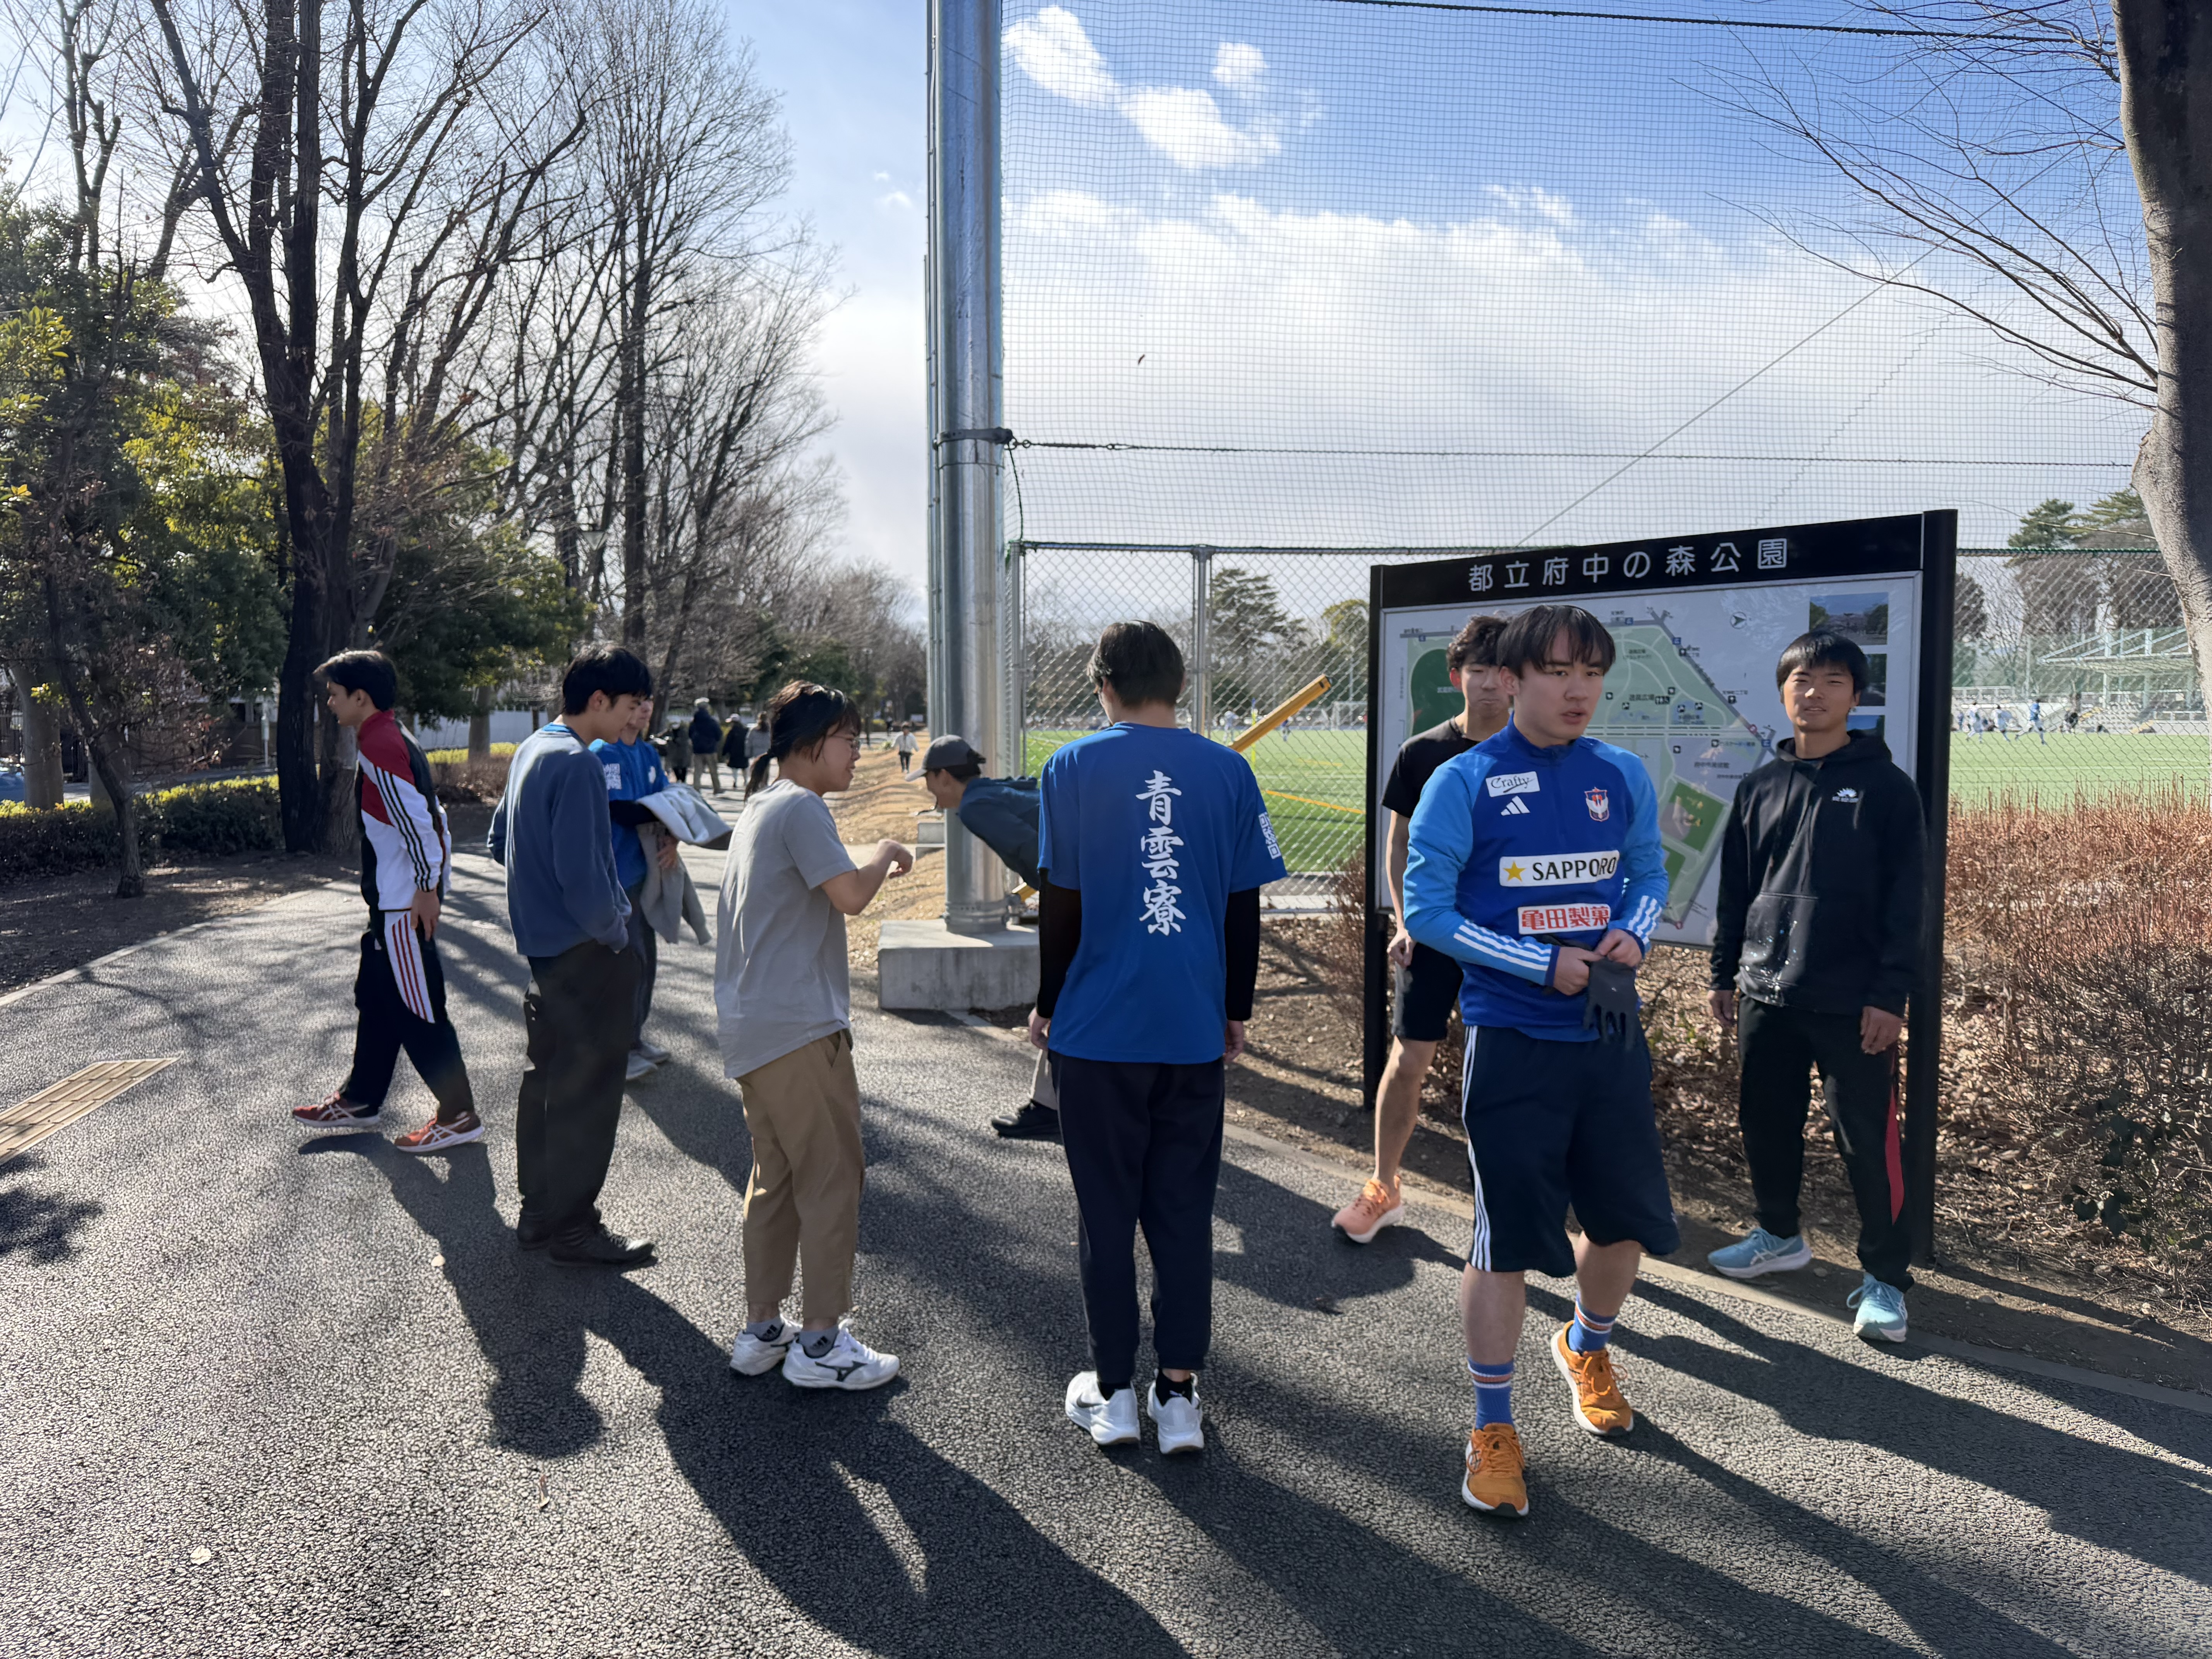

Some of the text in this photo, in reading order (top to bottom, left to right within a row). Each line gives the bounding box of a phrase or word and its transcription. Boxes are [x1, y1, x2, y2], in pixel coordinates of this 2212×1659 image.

[1468, 538, 1787, 592] 都立府中の森公園
[1491, 775, 1535, 793] Crafty
[1135, 769, 1186, 936] 青雲寮
[1532, 856, 1617, 881] SAPPORO
[1521, 905, 1609, 930] 亀田製菓
